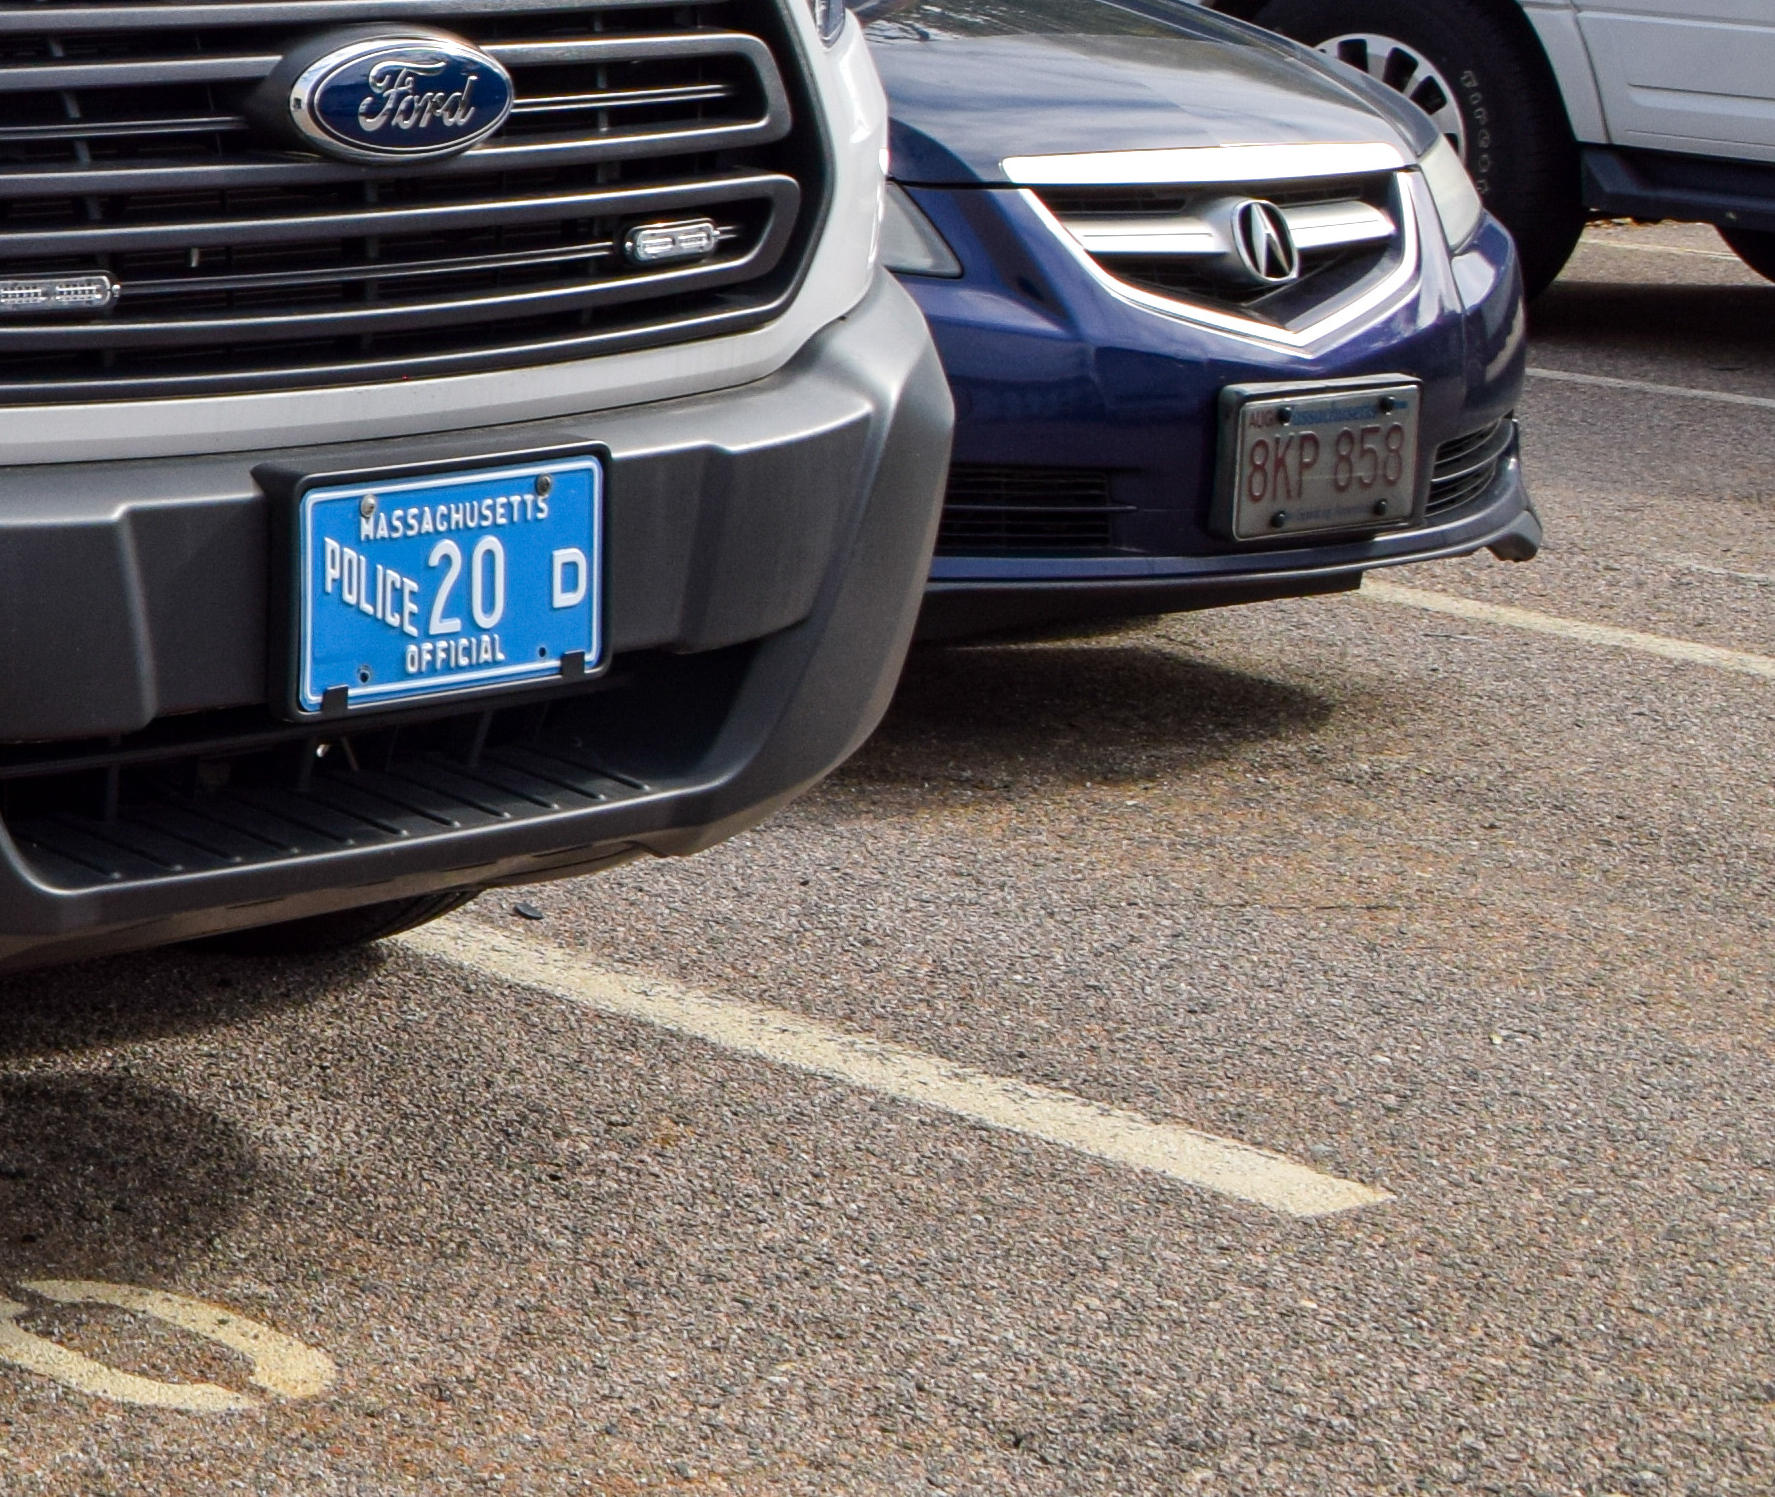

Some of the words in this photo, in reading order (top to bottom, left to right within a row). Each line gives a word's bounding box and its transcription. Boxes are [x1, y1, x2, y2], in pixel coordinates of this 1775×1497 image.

[358, 60, 478, 131] Ford
[1248, 431, 1319, 502] 8KP
[1334, 422, 1404, 492] 858
[360, 493, 549, 542] MASSACHUSETTS
[324, 536, 419, 637] POLICE
[428, 534, 505, 636] 20
[552, 547, 587, 609] D
[405, 633, 505, 674] OFFICIAL
